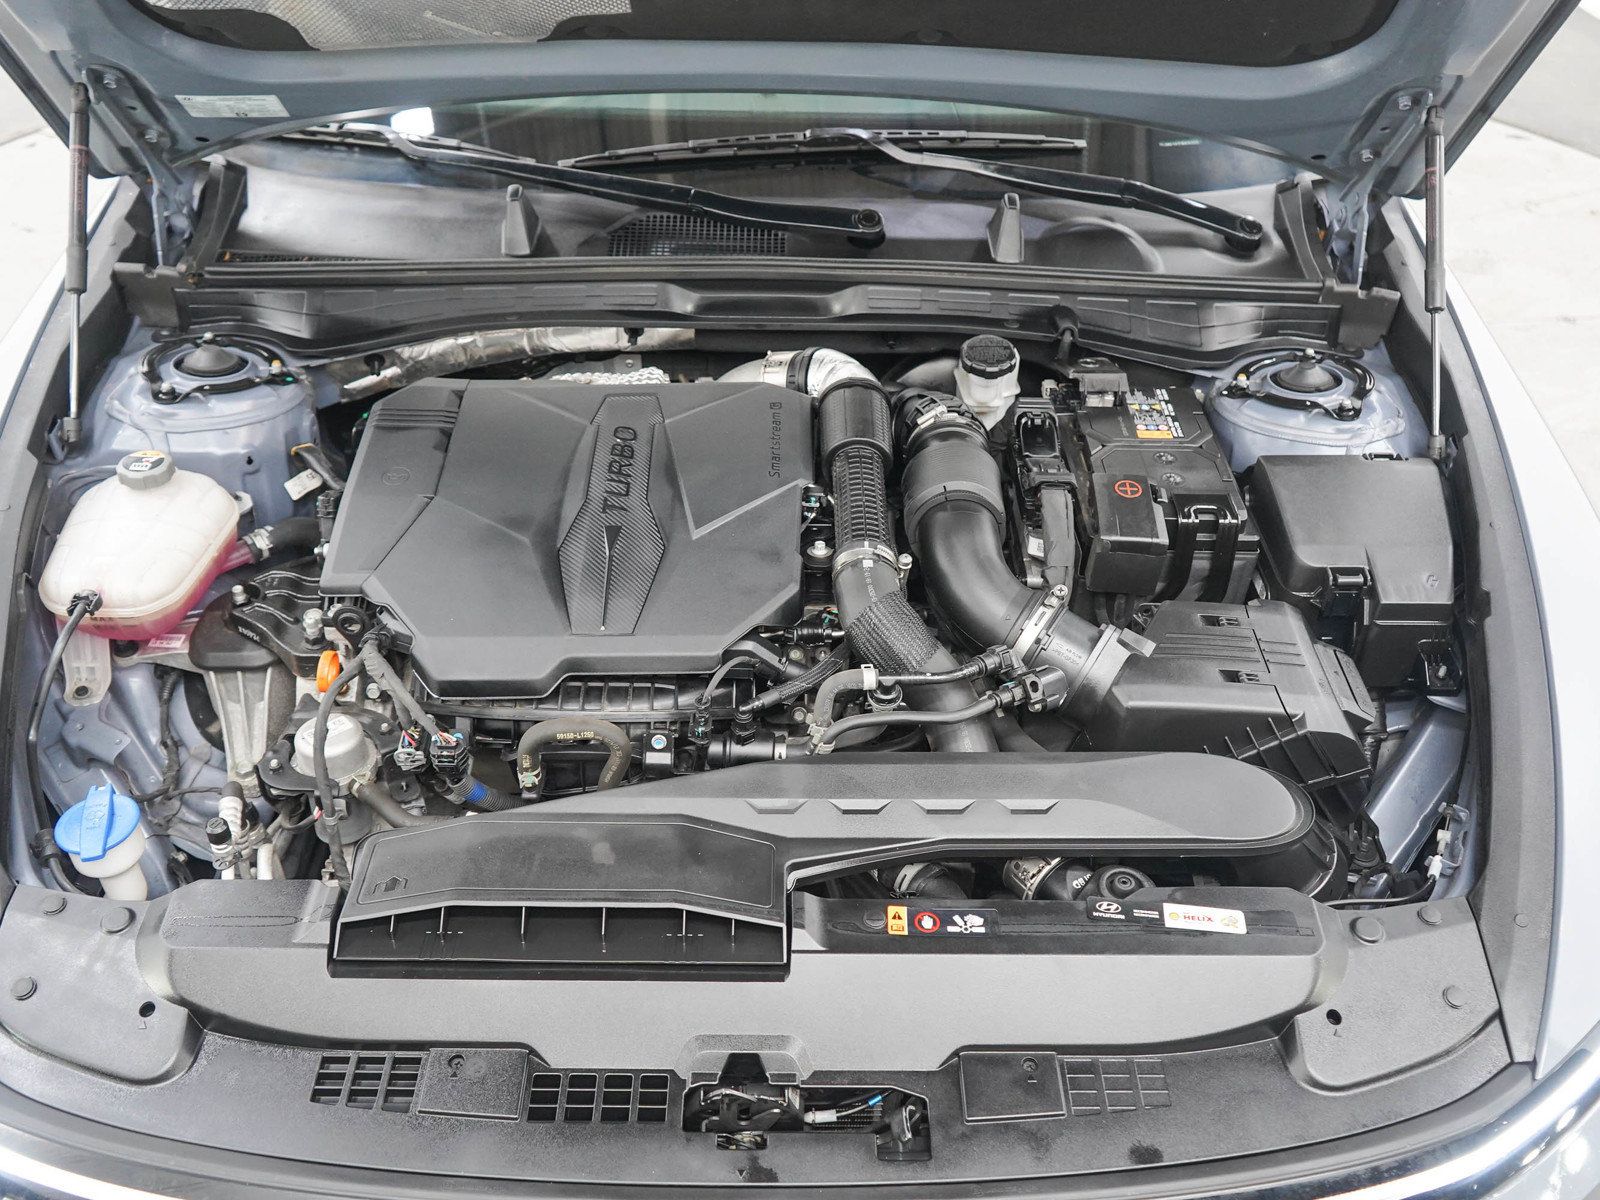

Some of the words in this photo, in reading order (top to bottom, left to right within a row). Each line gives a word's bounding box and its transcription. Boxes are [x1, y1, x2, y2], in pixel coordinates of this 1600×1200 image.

[768, 411, 781, 479] Smartstream
[601, 426, 637, 514] TURBO
[1092, 911, 1126, 920] HYUNDAI
[1183, 914, 1215, 923] HELIX
